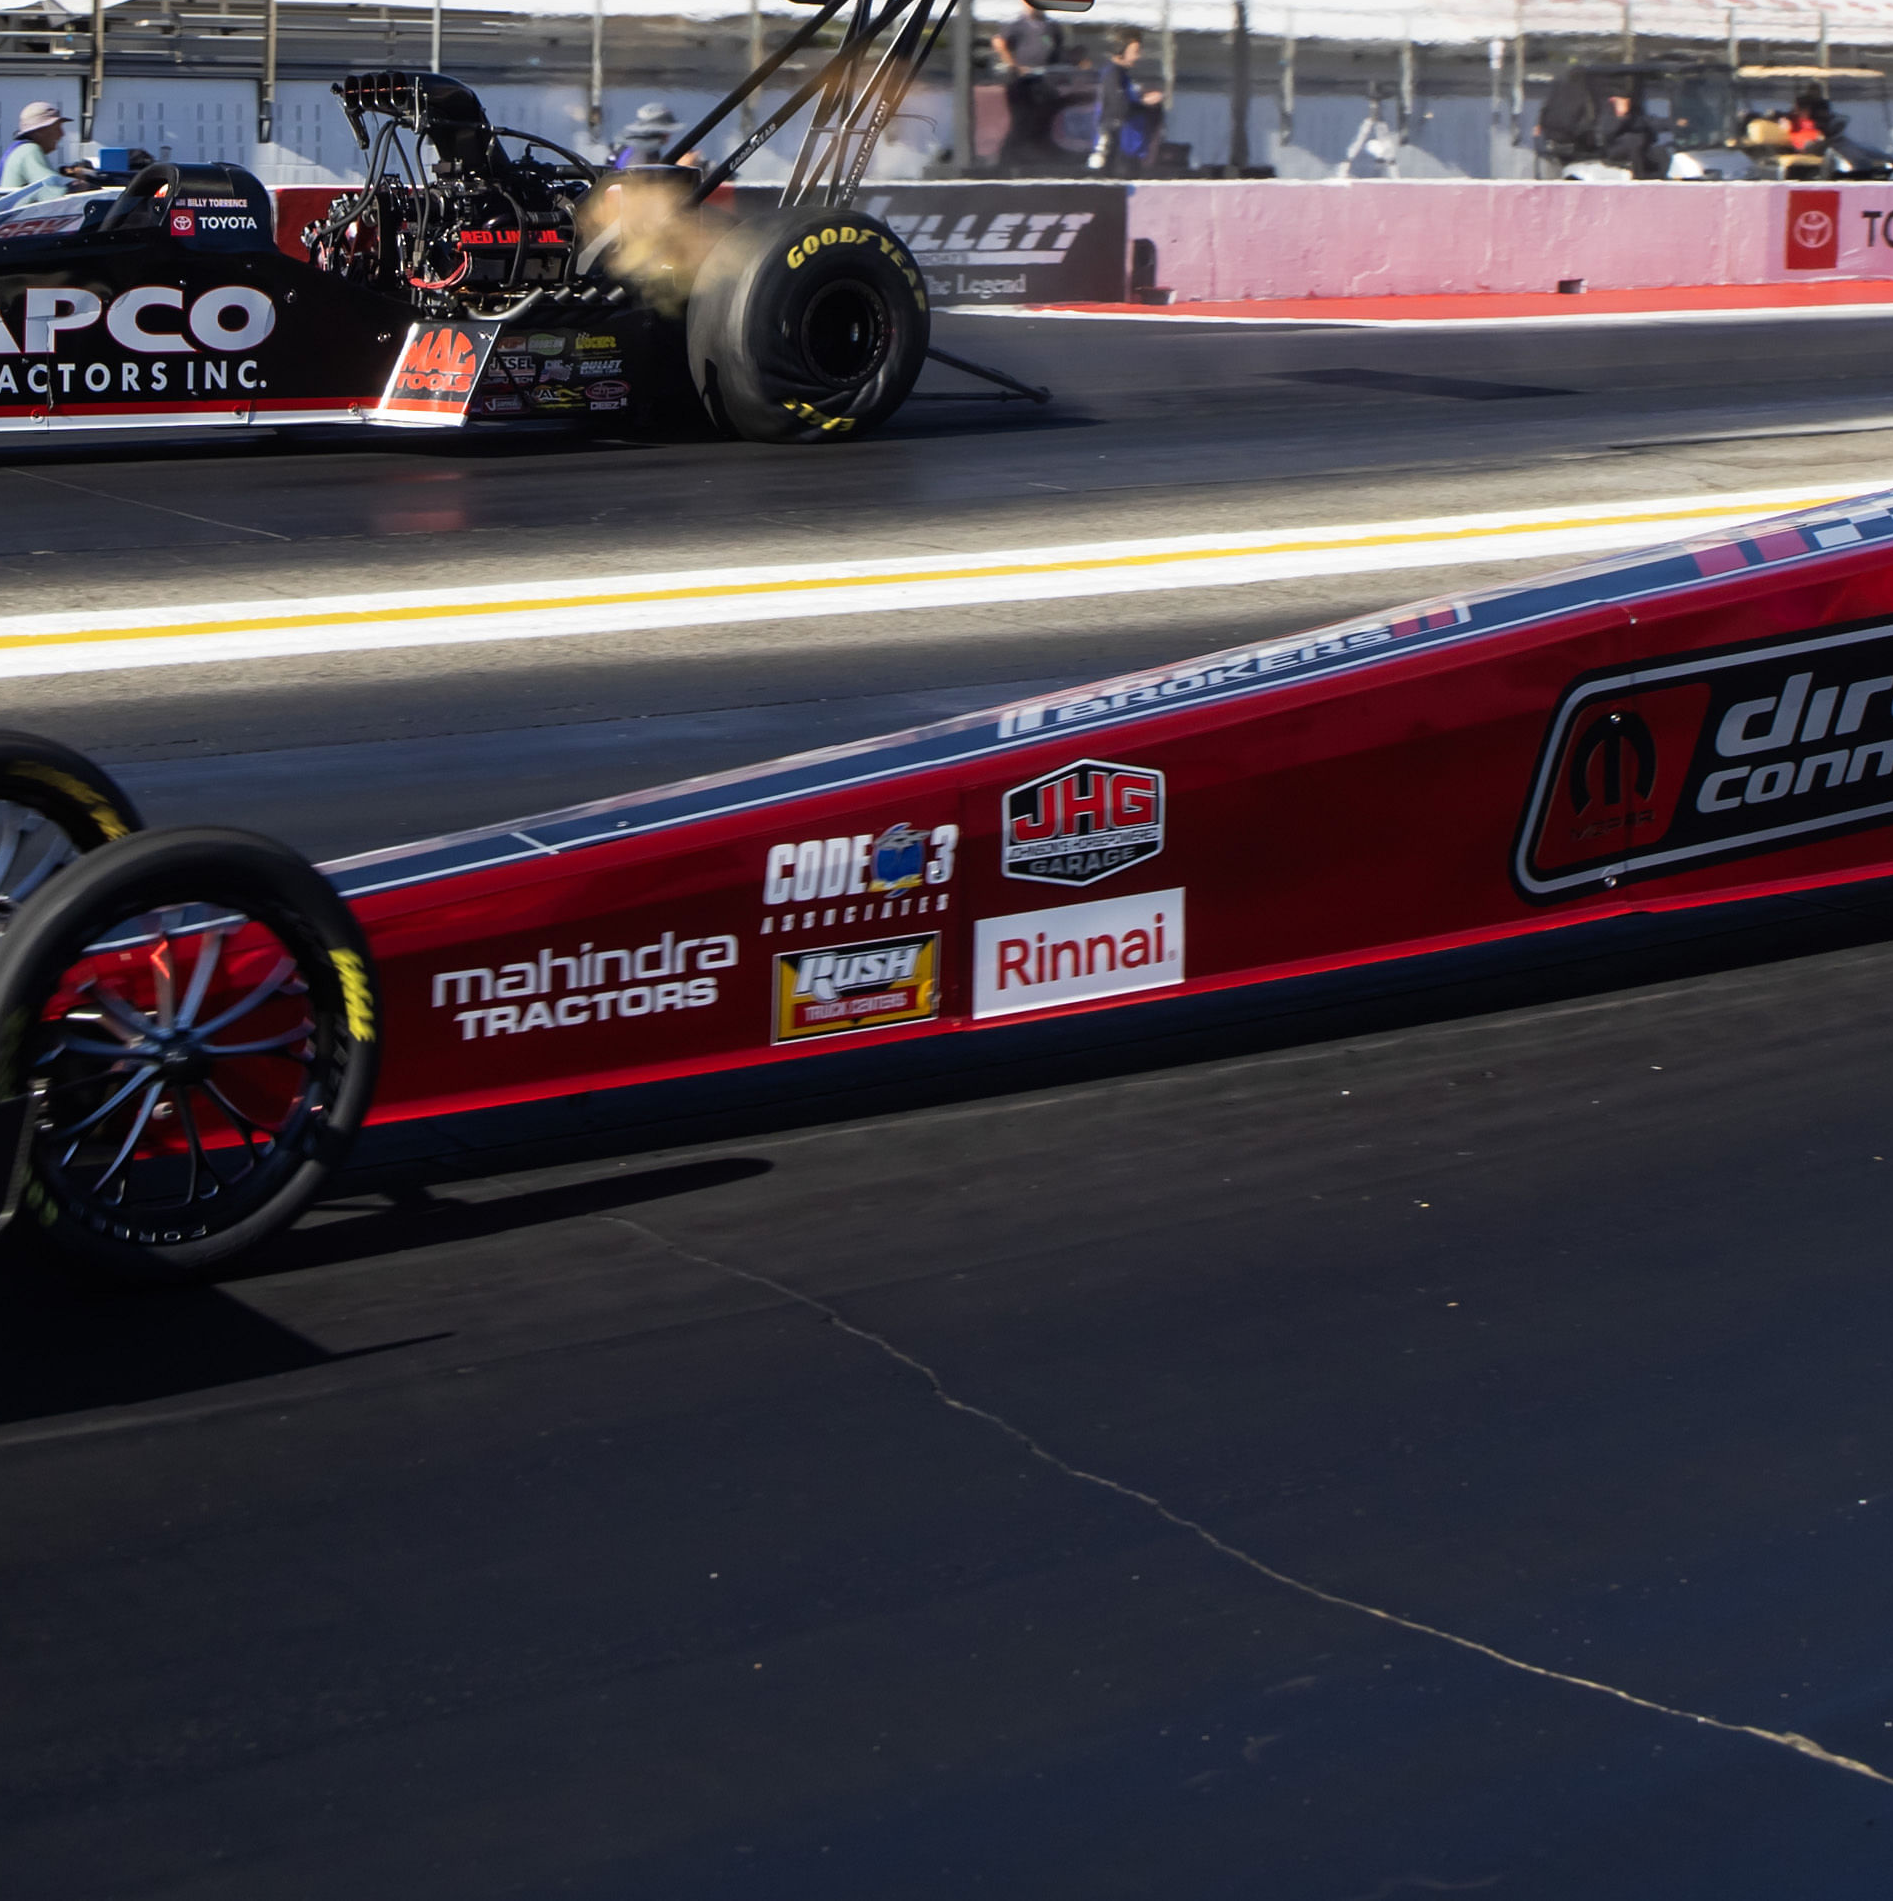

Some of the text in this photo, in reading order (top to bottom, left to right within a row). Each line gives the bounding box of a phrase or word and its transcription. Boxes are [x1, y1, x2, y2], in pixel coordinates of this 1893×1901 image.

[199, 216, 257, 230] TOYOTA
[460, 229, 495, 243] RED
[957, 272, 1027, 299] Legend
[400, 327, 477, 374] MAC
[187, 359, 268, 390] INC.
[396, 371, 474, 393] TOOLS
[1010, 771, 1157, 844] JHG
[762, 833, 874, 906] CODE
[924, 823, 959, 885] 3
[1029, 846, 1138, 875] GARAGE
[759, 893, 950, 935] ASSOCIATES
[432, 930, 738, 1008] mahindra
[997, 912, 1166, 991] Rinnai
[793, 944, 924, 1004] RUSH
[455, 977, 720, 1040] TRACTORS
